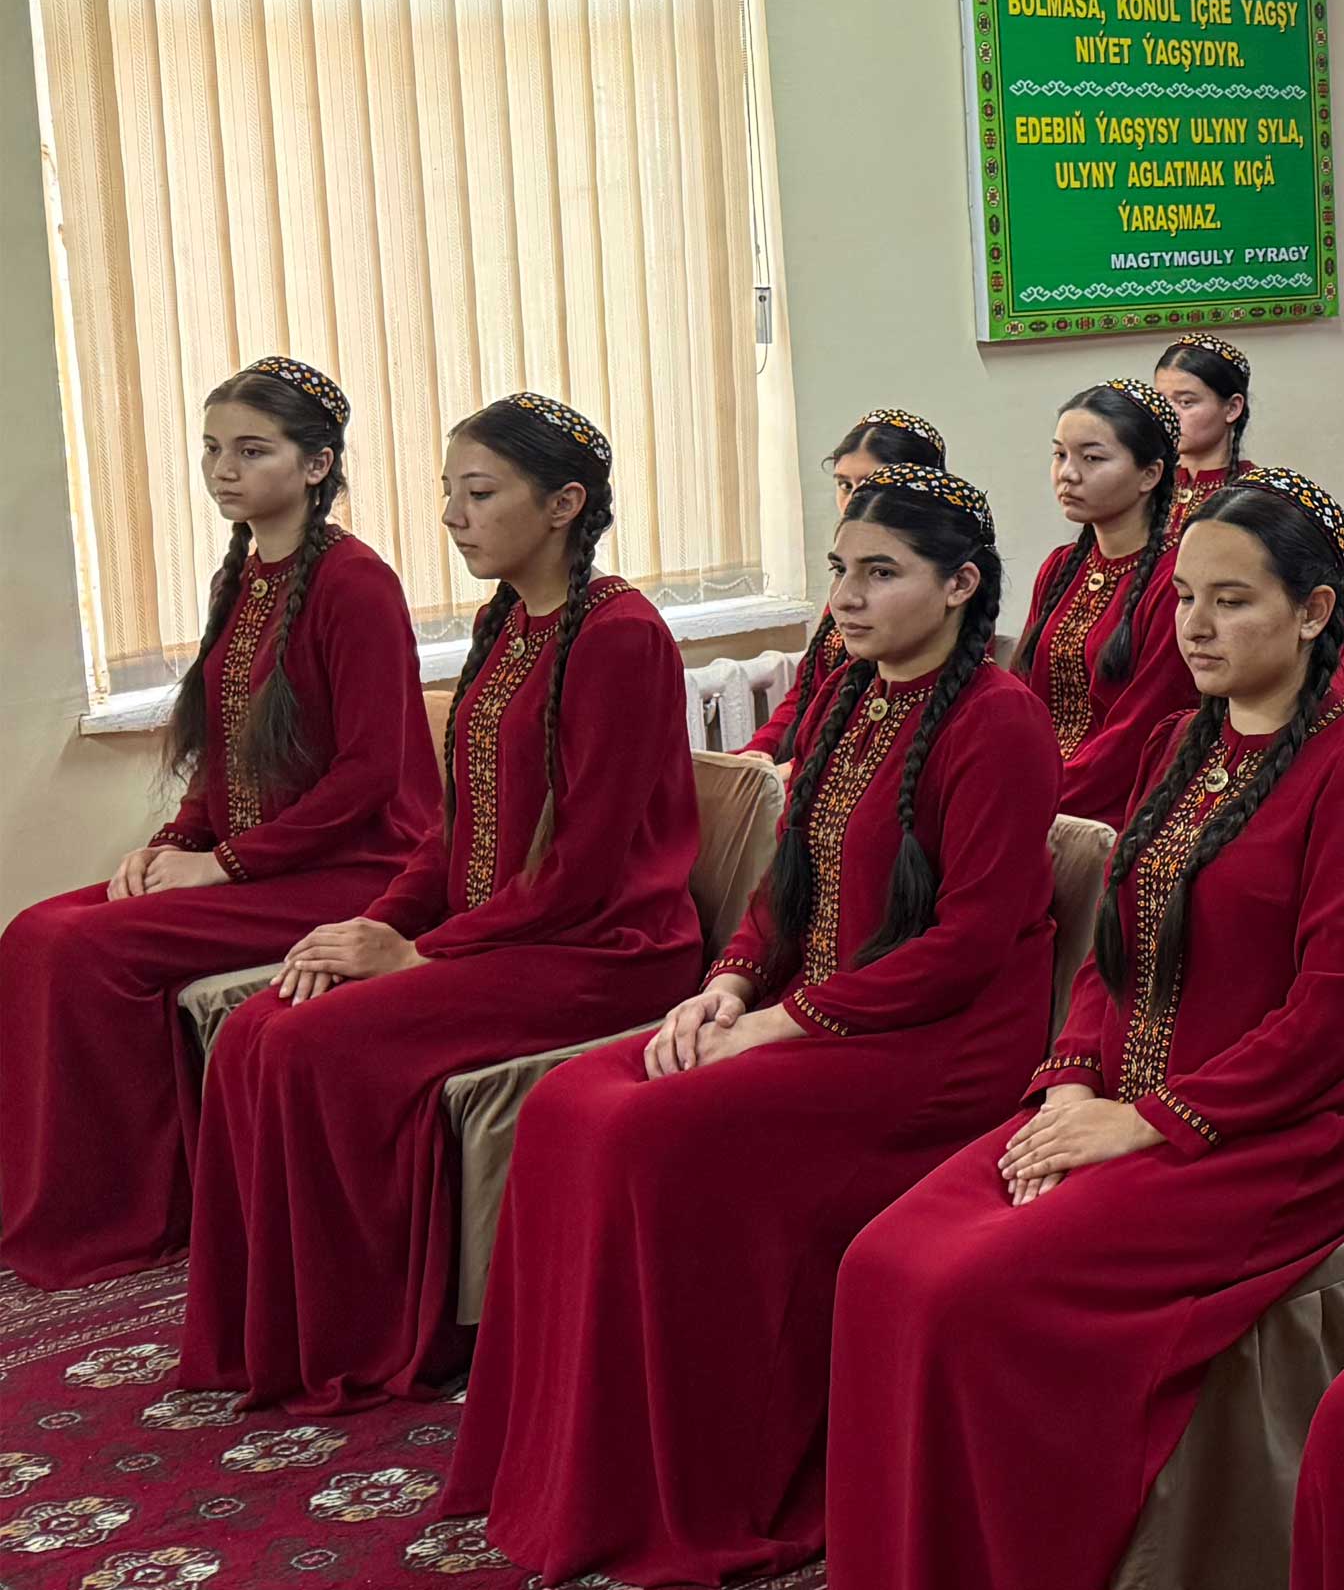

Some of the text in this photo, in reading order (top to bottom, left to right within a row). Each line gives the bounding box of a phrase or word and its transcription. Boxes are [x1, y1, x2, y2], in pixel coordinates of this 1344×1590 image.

[1076, 31, 1245, 72] NIÝET ÝAGŞYDYR.
[1015, 111, 1304, 150] EDEBIŇ ÝAGŞYSY ULYNY SYLA,
[1055, 154, 1275, 192] ULYNY AGLATMAK KIÇÄ
[1118, 200, 1222, 236] ÝARAŞMAZ.
[1110, 246, 1310, 270] MAGTYMGULY PYRAGY
